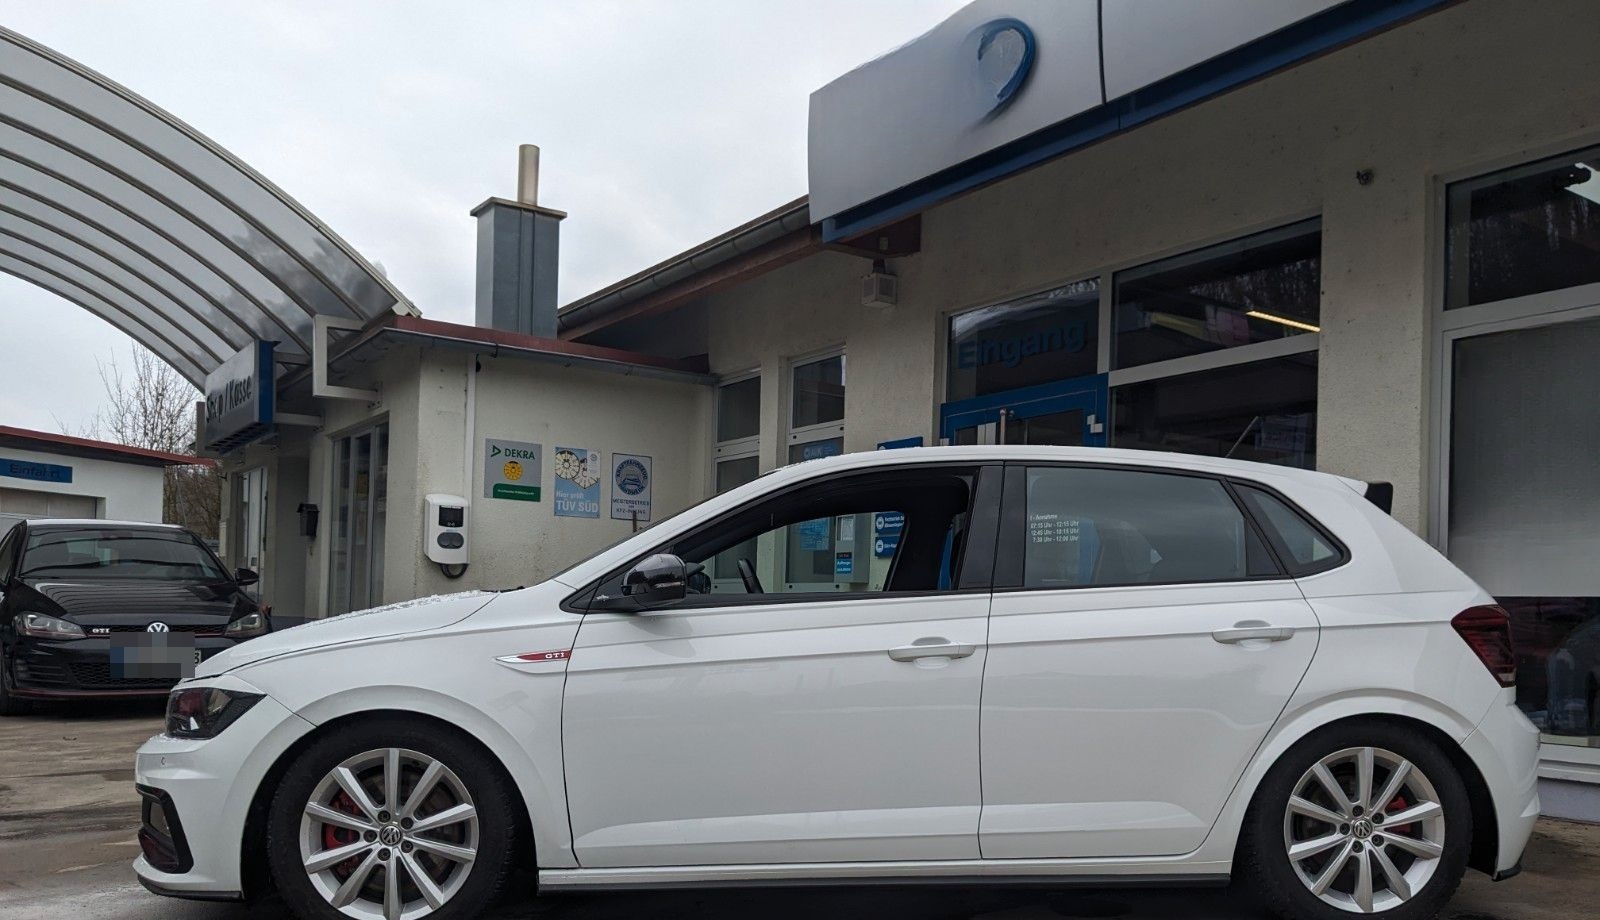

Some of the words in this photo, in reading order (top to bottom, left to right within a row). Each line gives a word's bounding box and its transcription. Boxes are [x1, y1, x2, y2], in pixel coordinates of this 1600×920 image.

[959, 320, 1087, 369] Eingang
[229, 375, 252, 410] Kasse
[504, 448, 536, 460] DEKRA
[556, 498, 576, 511] TÜV
